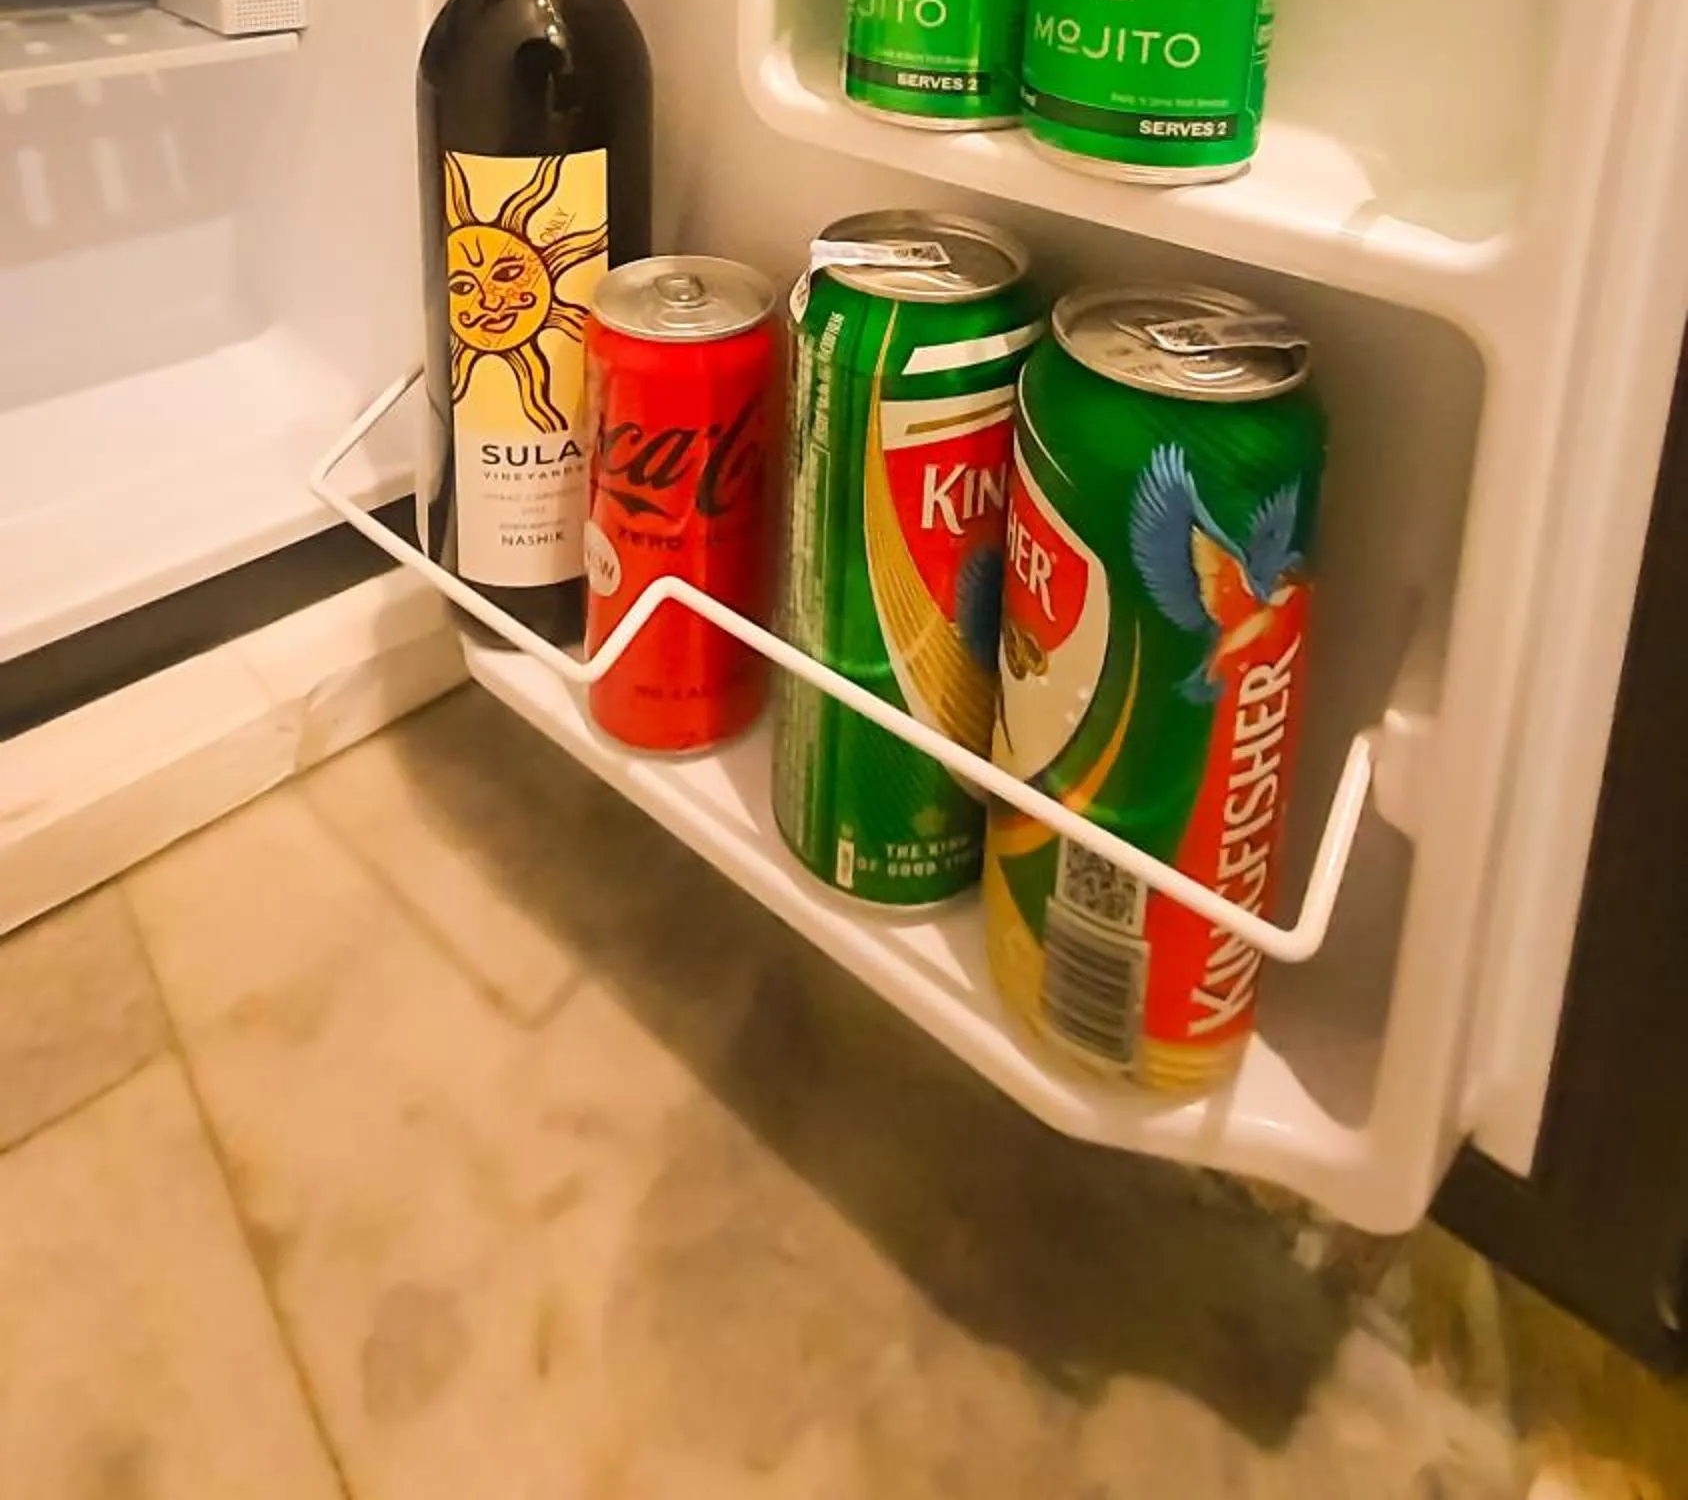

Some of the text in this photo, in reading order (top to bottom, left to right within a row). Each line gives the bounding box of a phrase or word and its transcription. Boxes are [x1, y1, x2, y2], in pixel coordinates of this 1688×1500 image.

[1033, 10, 1201, 69] MOJITO
[896, 71, 978, 91] SERVES 2
[1139, 119, 1228, 137] SERVES 2
[481, 439, 583, 467] SULA
[501, 530, 567, 547] NASHIK
